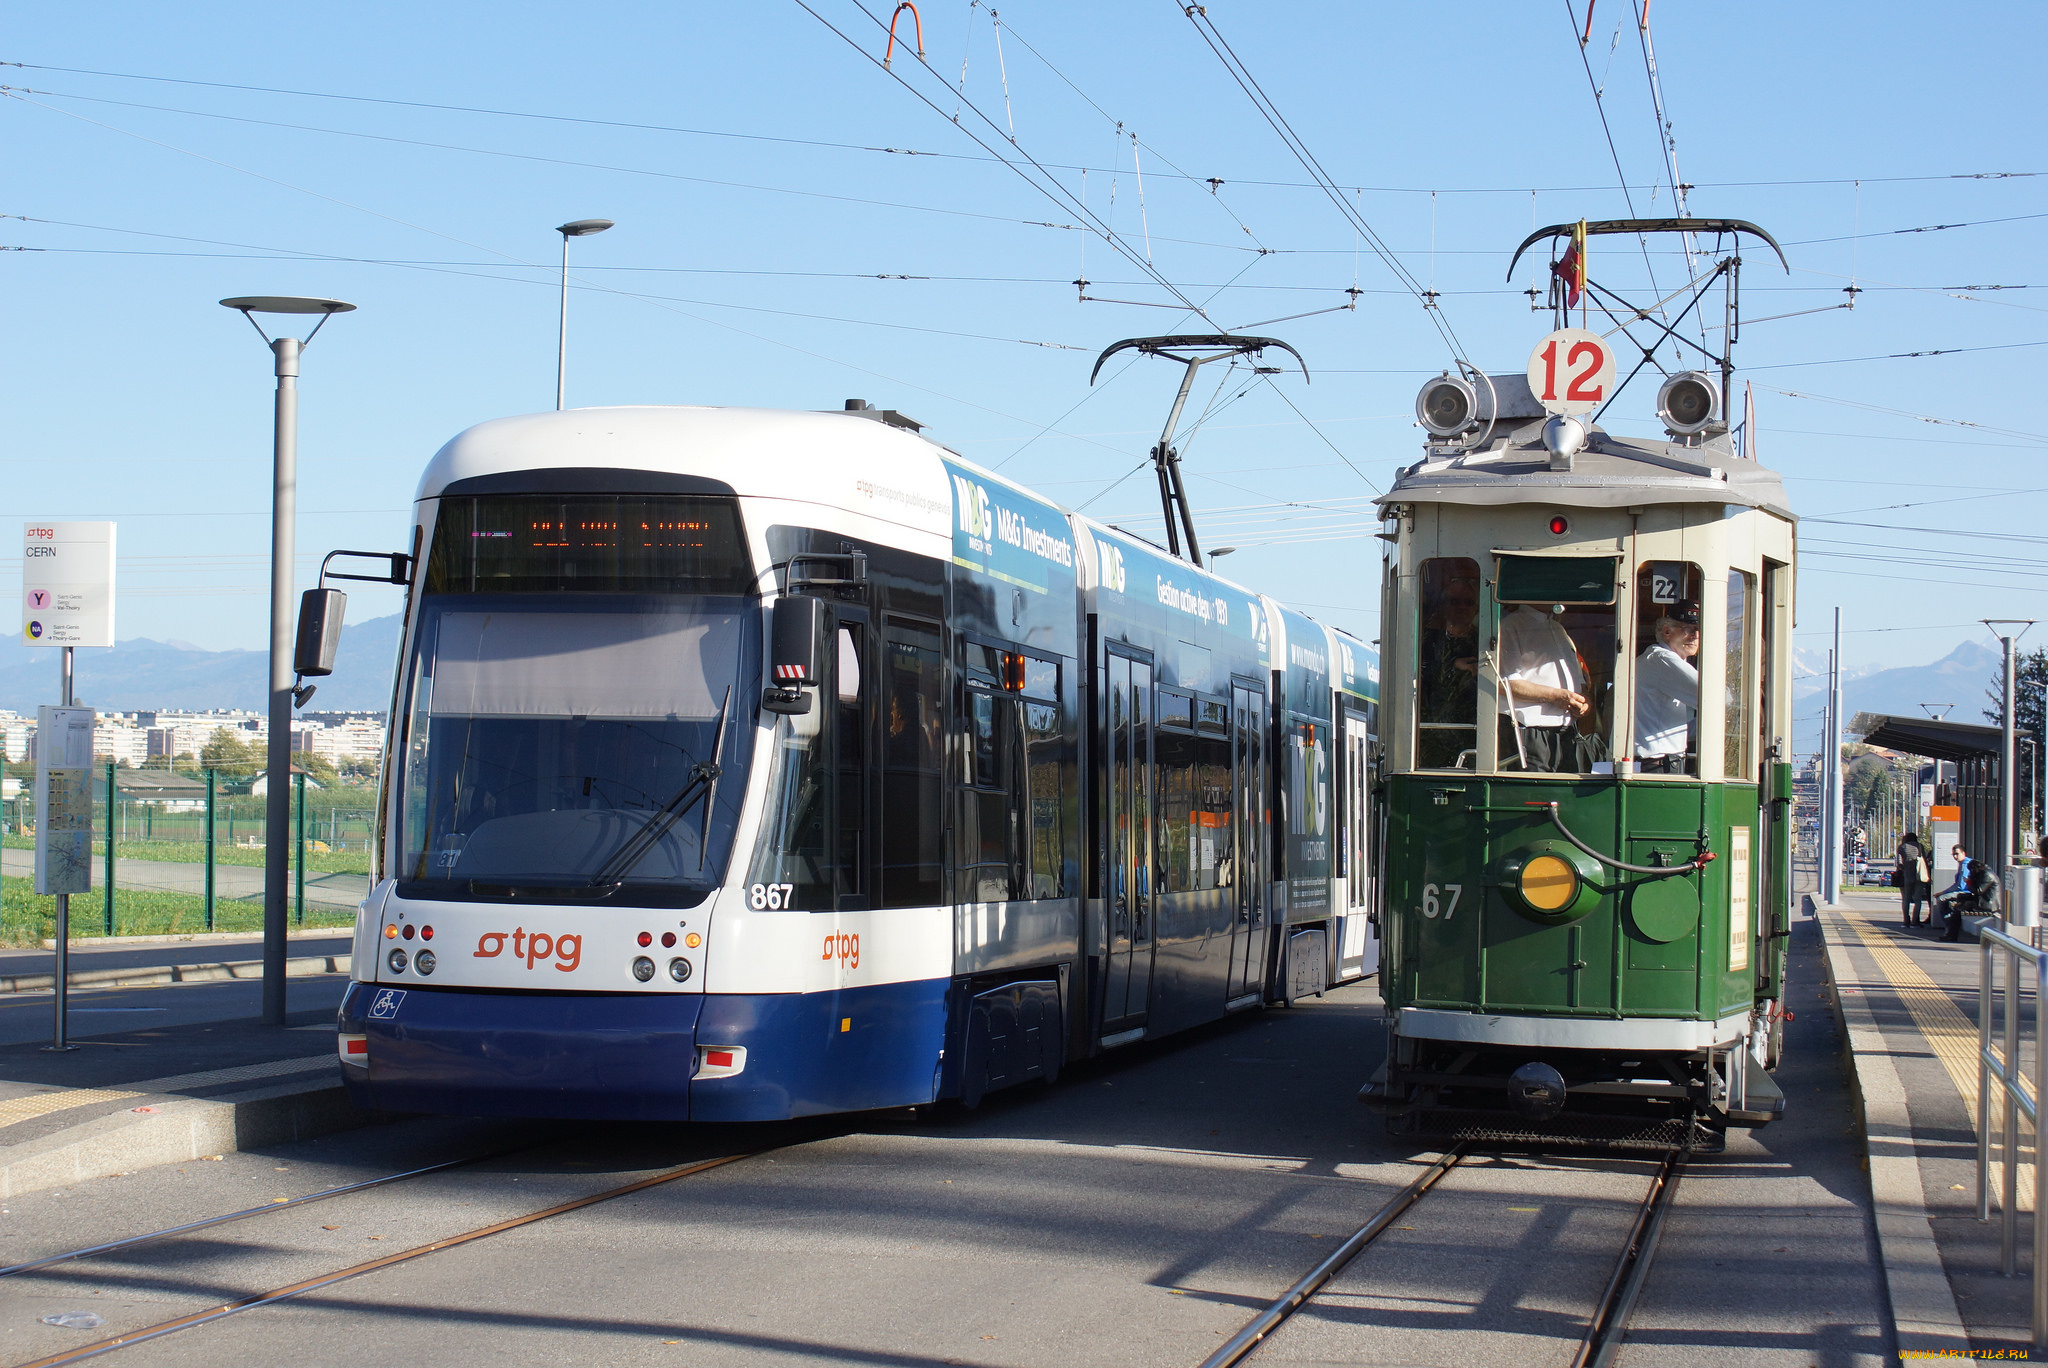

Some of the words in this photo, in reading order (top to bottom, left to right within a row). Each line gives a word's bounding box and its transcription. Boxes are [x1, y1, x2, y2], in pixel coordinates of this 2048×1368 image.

[1540, 340, 1604, 401] 12
[952, 474, 992, 541] M&G
[26, 546, 57, 558] CERN
[37, 527, 54, 540] tpg
[995, 504, 1021, 548] M&G
[1020, 515, 1072, 568] Investments
[1097, 539, 1126, 594] M&G
[34, 593, 44, 605] Y
[1156, 574, 1180, 609] Gestion
[1180, 587, 1198, 616] active
[1655, 579, 1678, 599] 22
[31, 625, 42, 633] NA
[1290, 734, 1326, 837] M&G
[751, 883, 794, 910] 867
[1422, 883, 1462, 920] 67
[512, 926, 582, 972] tpg
[835, 929, 860, 970] tpg
